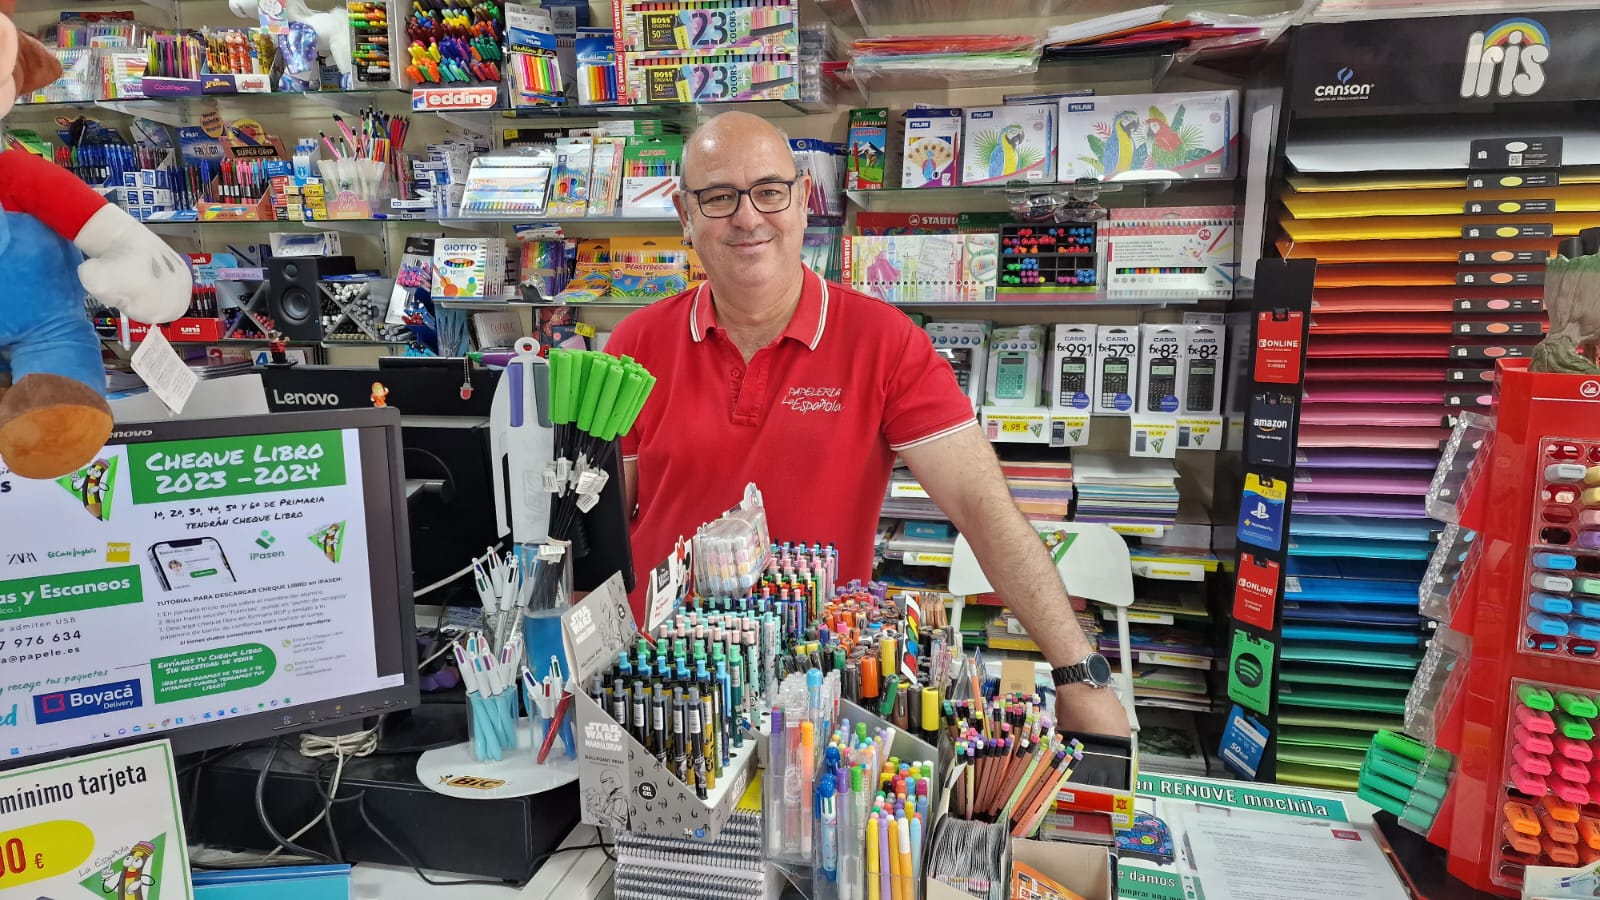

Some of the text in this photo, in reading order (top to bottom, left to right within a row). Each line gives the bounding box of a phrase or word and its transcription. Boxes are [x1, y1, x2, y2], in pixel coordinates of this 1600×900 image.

[652, 30, 660, 38] 50
[692, 12, 728, 46] 23
[694, 66, 729, 98] 23
[1314, 84, 1371, 96] CANSON
[428, 91, 492, 106] edding
[1200, 230, 1210, 238] 24
[180, 326, 200, 334] uni
[1057, 343, 1093, 358] fx-991
[1099, 344, 1136, 358] fx-570
[1149, 344, 1179, 358] fx-82
[1188, 344, 1218, 359] fx-82
[1267, 340, 1298, 348] ONLINE
[273, 389, 339, 406] Lenovo
[1002, 423, 1020, 432] 6,95
[1254, 419, 1288, 428] amazon
[109, 428, 152, 438] enovo
[146, 443, 324, 471] CHEQUE LIBRO
[156, 471, 227, 494] 2023
[280, 496, 325, 506] PRIMARIA
[186, 511, 303, 530] TENDRÁN CHEQUE LIBRO
[250, 550, 285, 561] iPasen
[21, 590, 35, 606] y
[40, 578, 130, 599] Escaneos
[157, 598, 192, 606] TUTORIAL
[214, 588, 257, 599] DESCARGAR
[258, 584, 286, 592] CHEQUE
[1246, 581, 1274, 596] ONLINE
[10, 616, 76, 632] admiten USB
[14, 636, 44, 648] 976
[52, 630, 82, 644] 634
[8, 669, 108, 693] recoge tus paquetes
[104, 699, 134, 710] Delivery
[584, 722, 620, 732] STAR
[585, 730, 622, 742] WARS
[1, 766, 147, 814] mínimo tarjeta
[1160, 780, 1236, 803] RENOVE
[1244, 793, 1329, 816] mochila
[34, 852, 44, 870] €
[1130, 870, 1176, 888] damos
[1118, 888, 1149, 898] omprar
